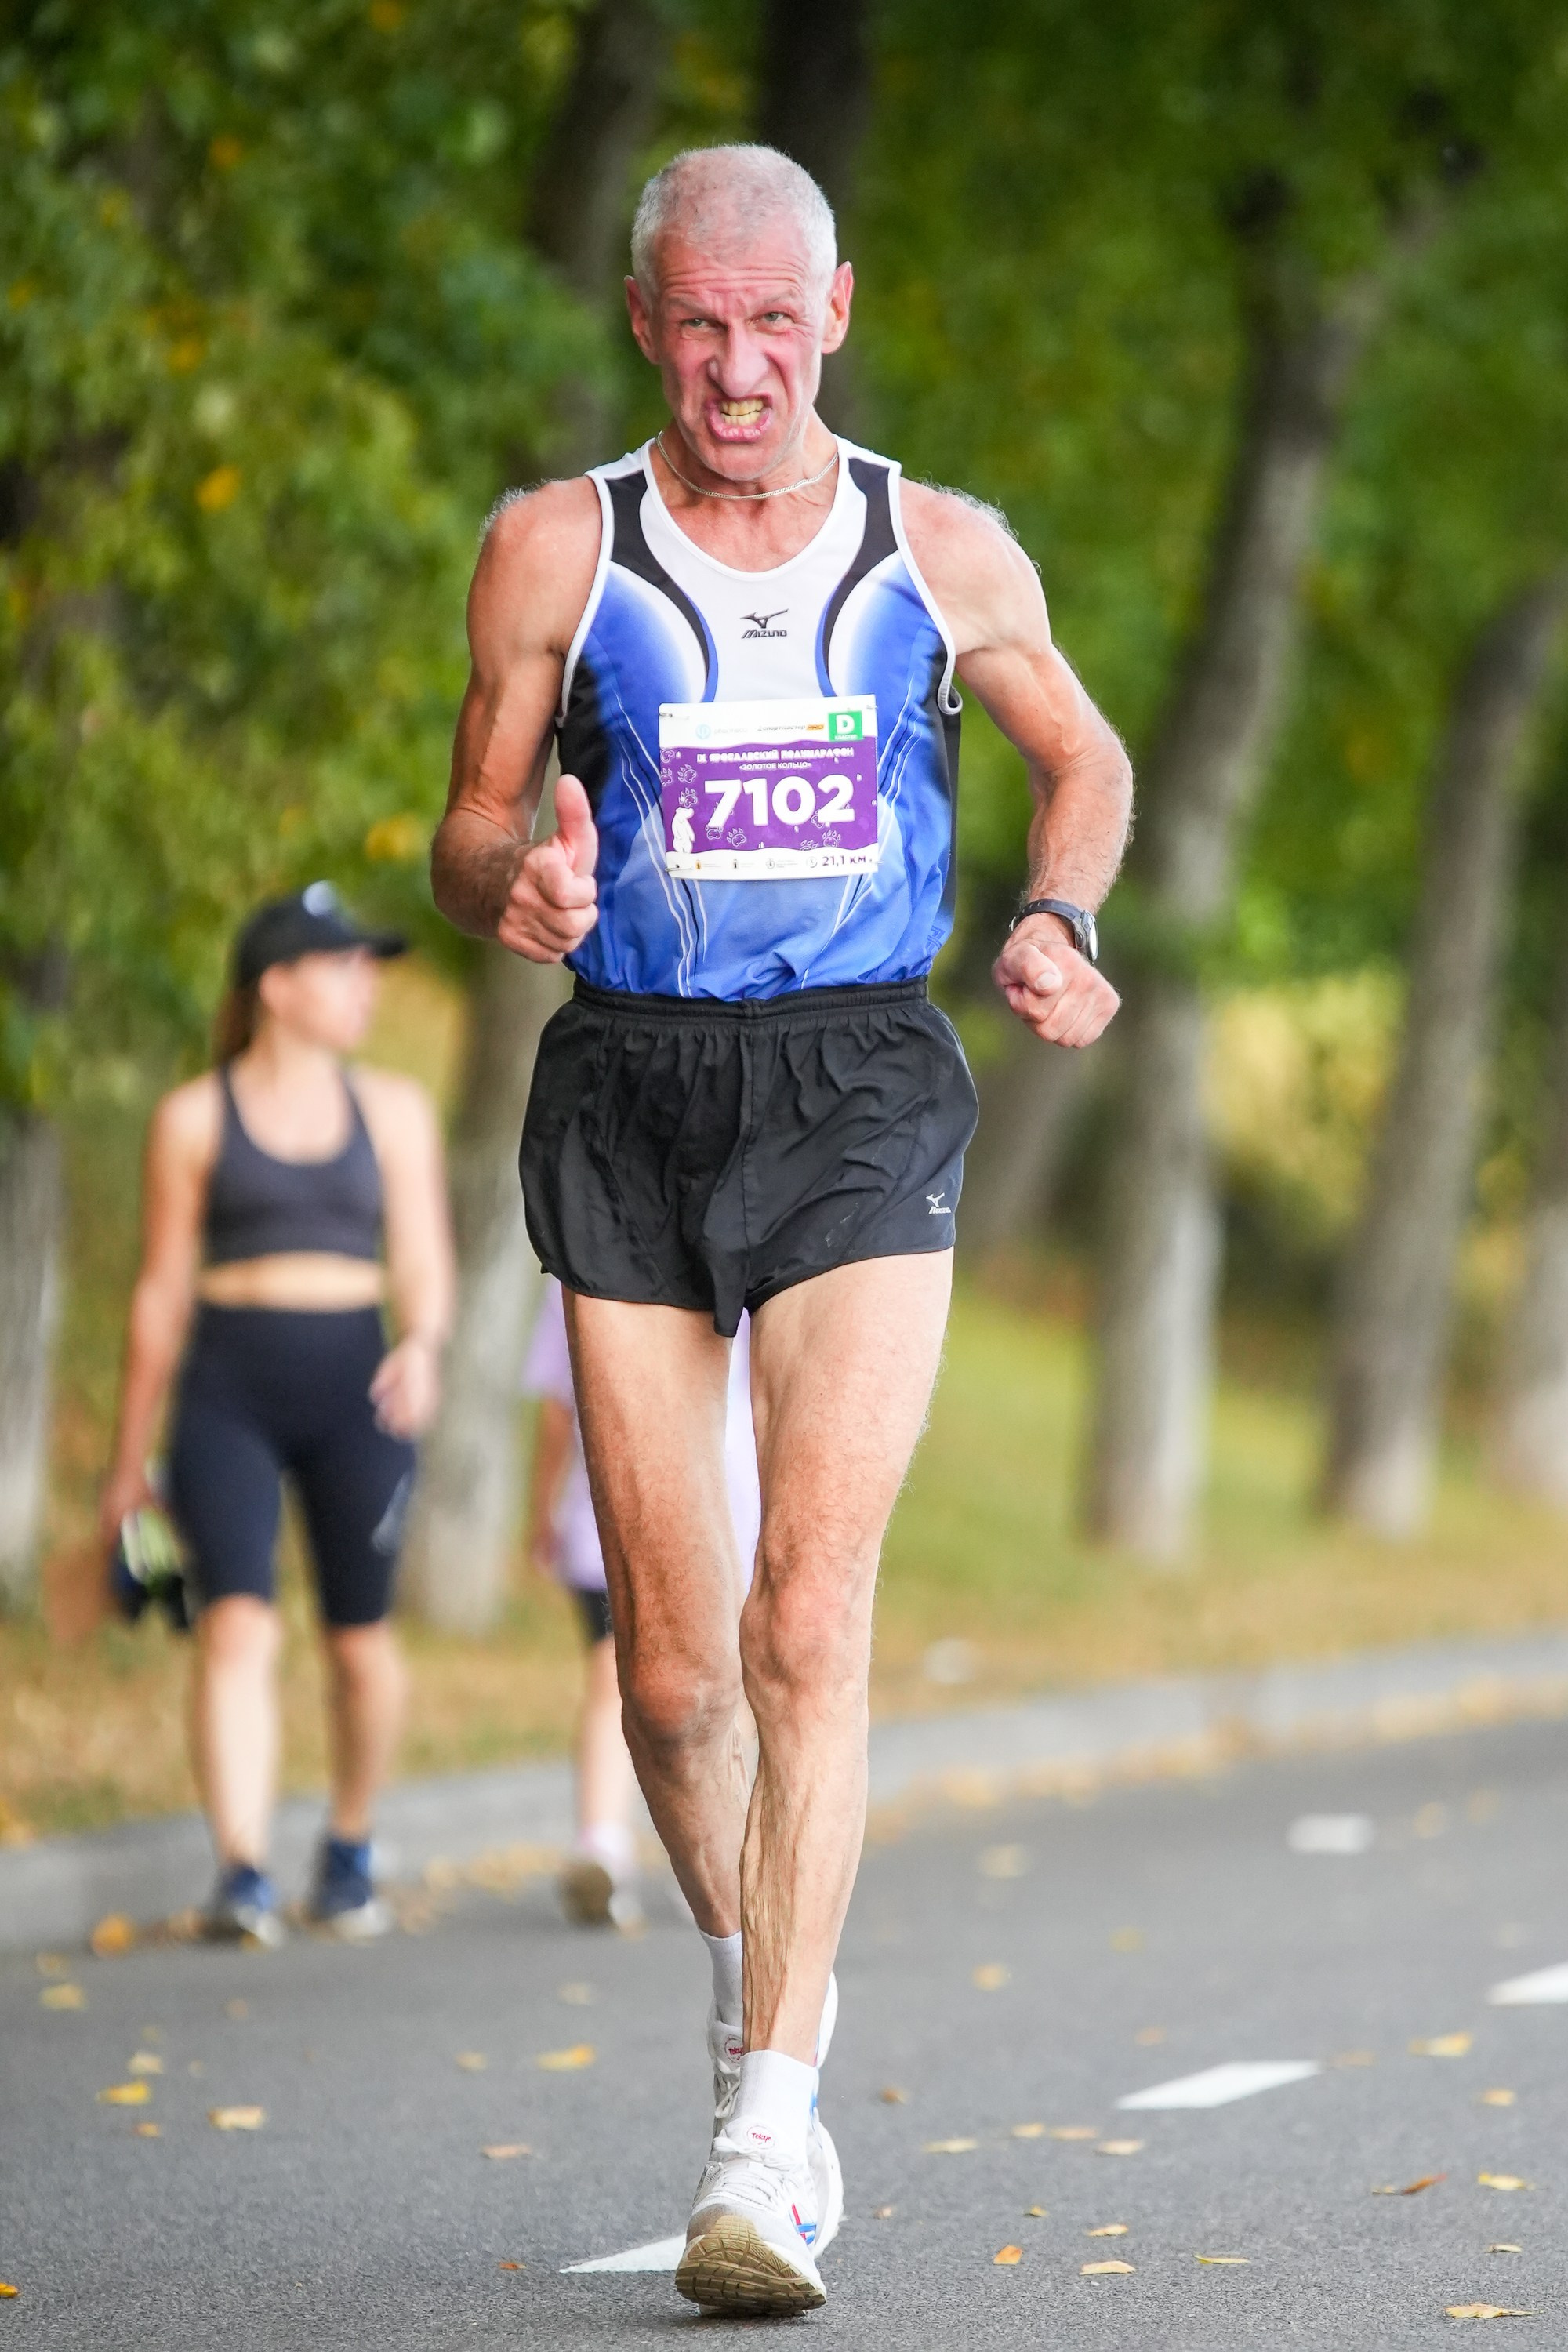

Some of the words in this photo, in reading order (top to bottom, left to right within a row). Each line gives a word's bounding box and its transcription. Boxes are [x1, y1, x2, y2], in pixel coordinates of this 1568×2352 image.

[836, 714, 855, 734] D
[709, 750, 779, 762] ЯРОСЛАВСКИЙ
[781, 747, 854, 760] ПОЛУМАРАФОН
[704, 774, 855, 827] 7102
[822, 855, 844, 866] 21,1
